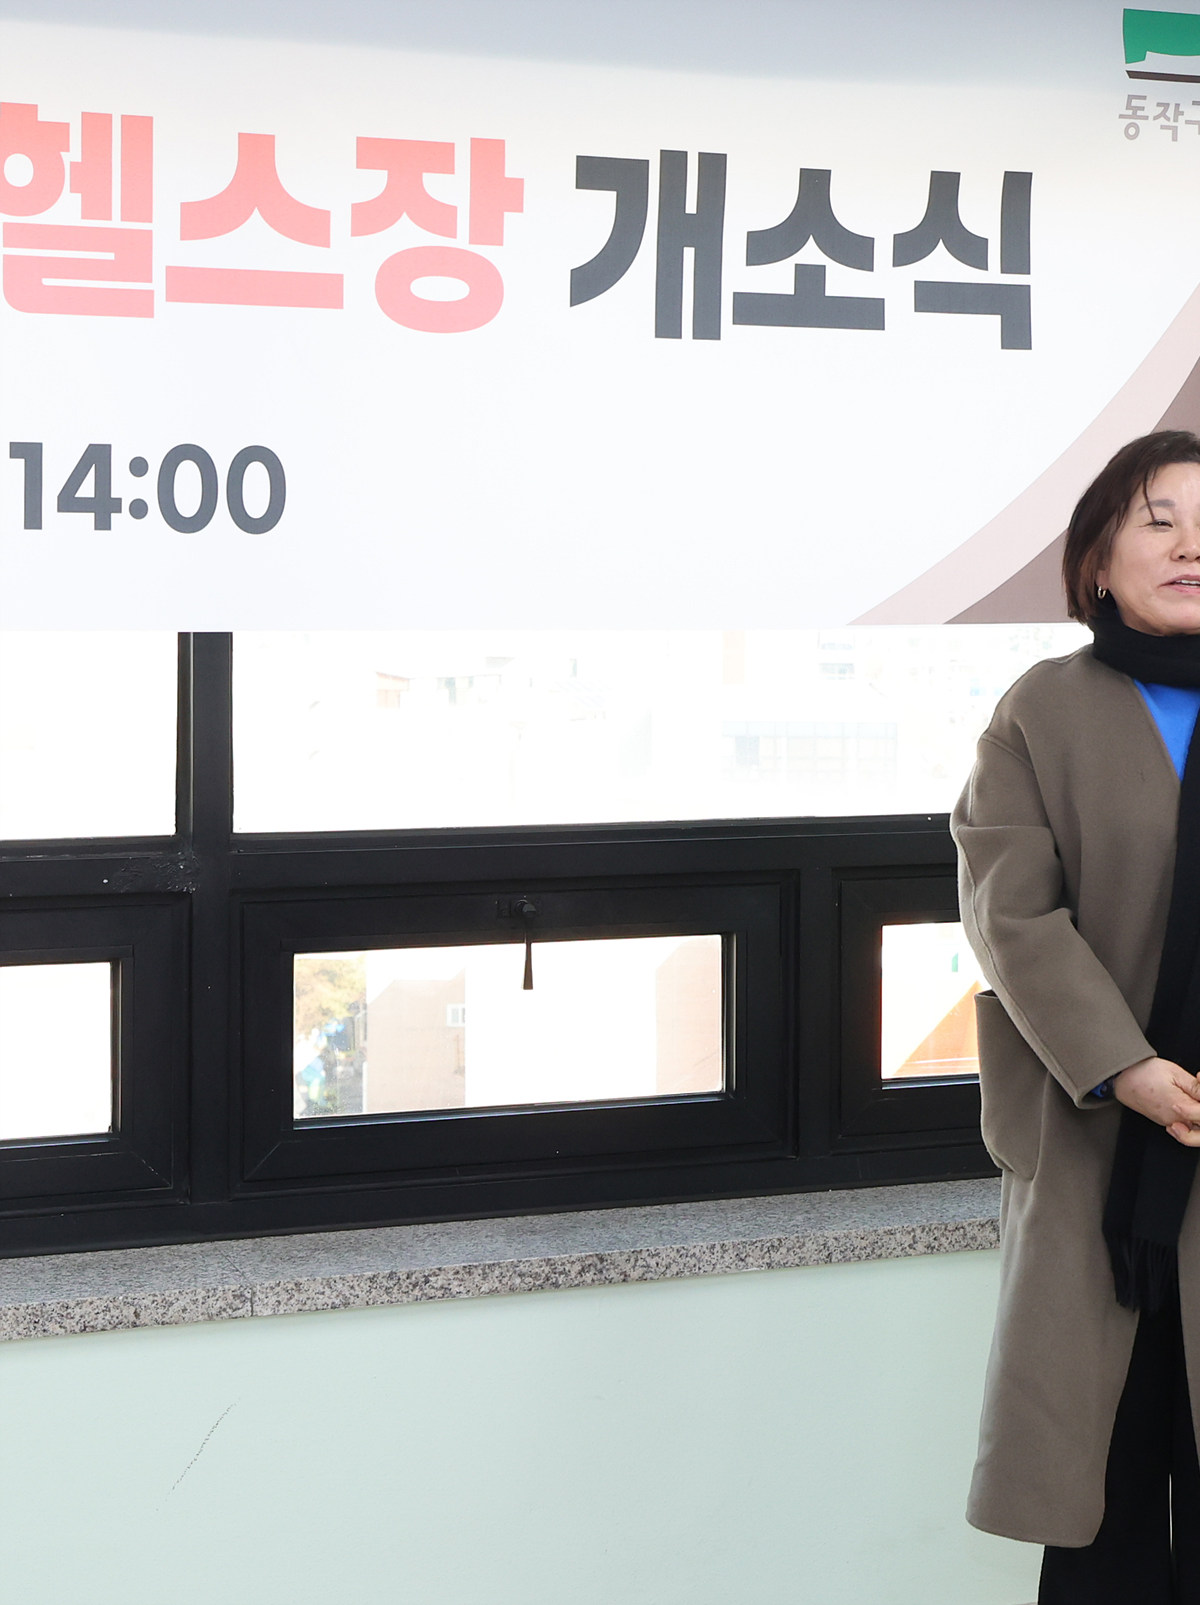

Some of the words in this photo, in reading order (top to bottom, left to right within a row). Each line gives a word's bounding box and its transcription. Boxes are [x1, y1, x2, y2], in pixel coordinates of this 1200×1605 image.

[0, 101, 525, 334] 헬스장
[569, 149, 1034, 351] 개소식
[9, 441, 287, 535] 14:00
